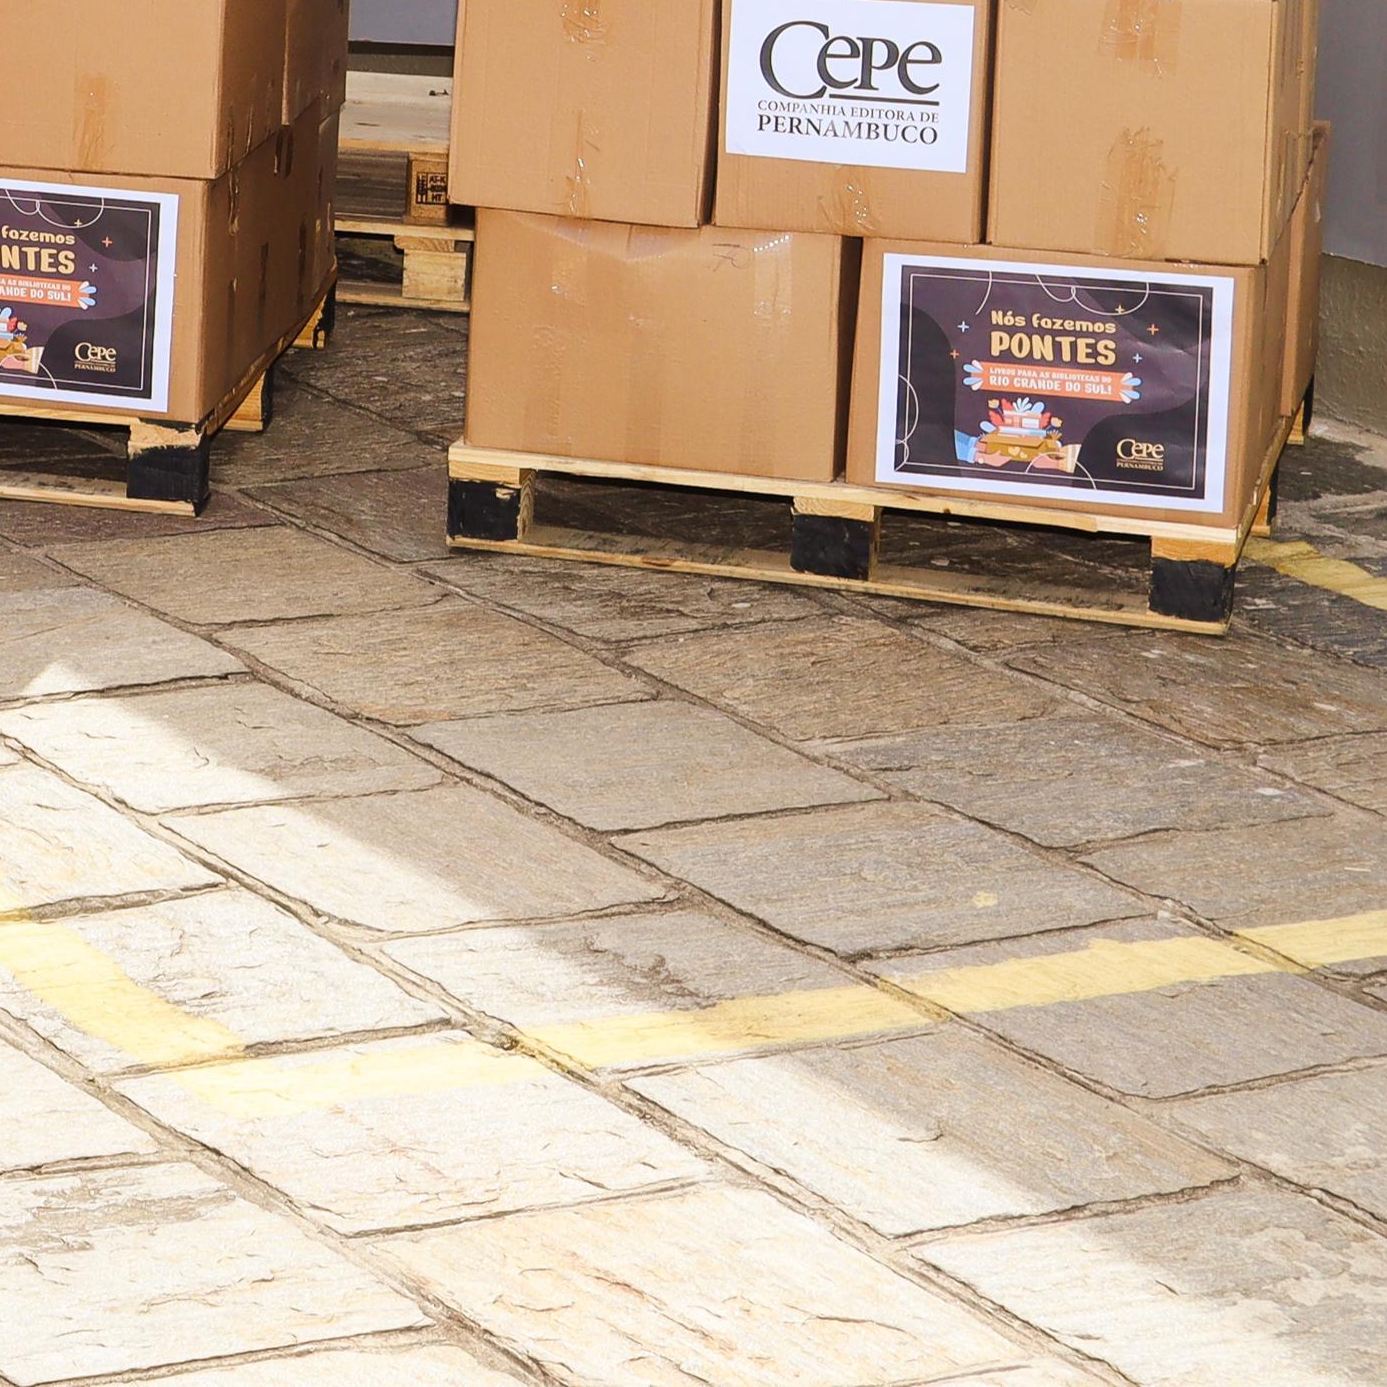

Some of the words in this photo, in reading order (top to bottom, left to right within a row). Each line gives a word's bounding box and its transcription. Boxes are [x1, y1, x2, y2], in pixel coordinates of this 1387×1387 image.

[757, 99, 845, 116] COMPANHIA
[850, 107, 914, 121] EDITORA
[920, 112, 939, 124] DE
[757, 114, 938, 145] PERNAMBUCO
[0, 224, 75, 245] fazemos
[29, 288, 44, 299] DO
[46, 290, 71, 302] SUL!
[990, 310, 1026, 326] Nós
[1031, 312, 1116, 333] fazemos
[990, 330, 1116, 365] PONTES
[989, 374, 1010, 386] RIO
[1012, 376, 1061, 391] GRANDE
[1064, 380, 1081, 392] DO
[1084, 382, 1112, 395] SUL!
